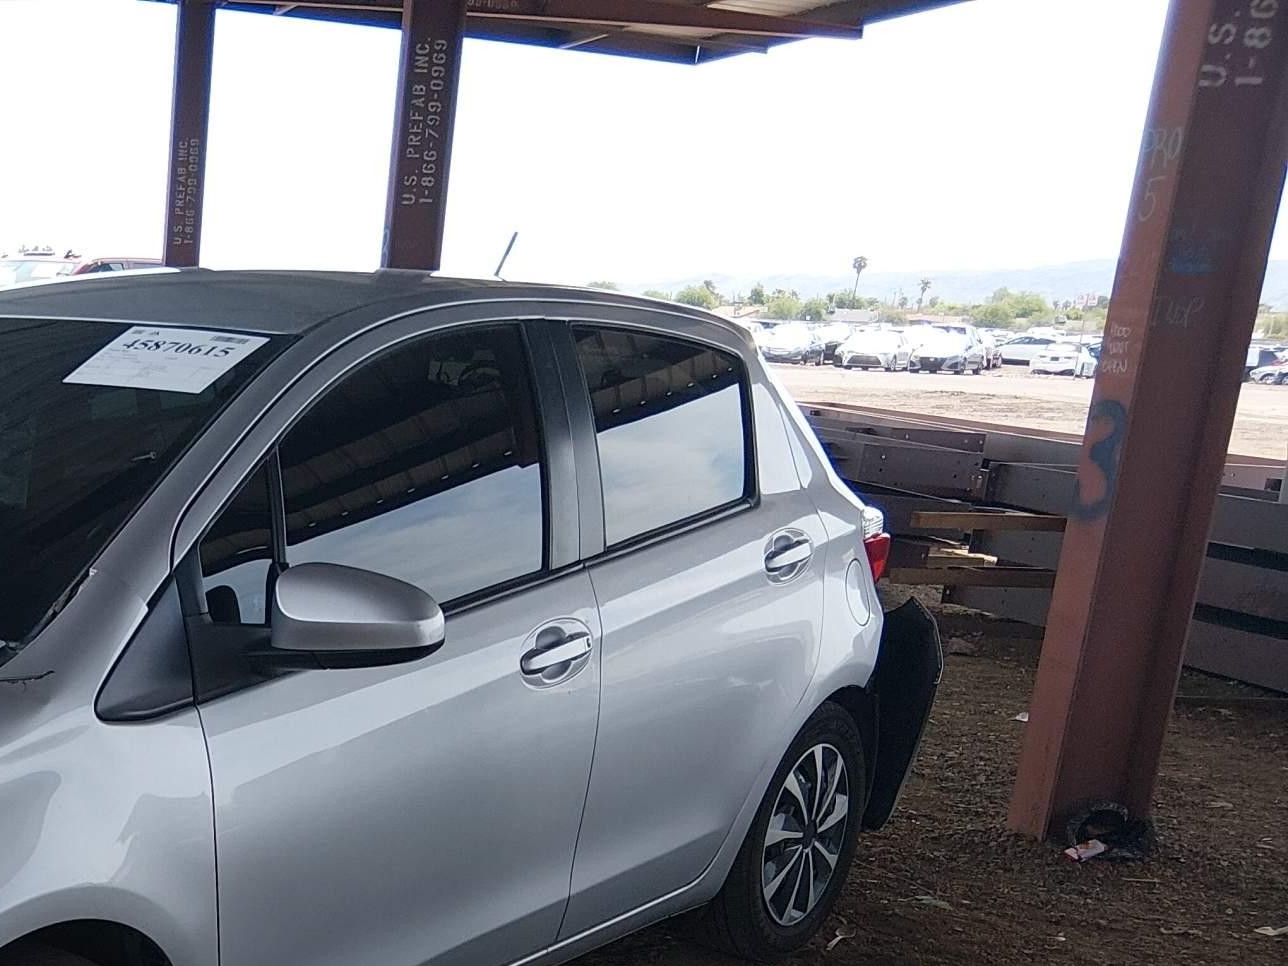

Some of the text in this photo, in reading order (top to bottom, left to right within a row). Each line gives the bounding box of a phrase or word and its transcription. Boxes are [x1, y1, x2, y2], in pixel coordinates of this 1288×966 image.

[1198, 10, 1241, 87] U.S.
[400, 37, 432, 206] U.S. PREFAB INC.
[419, 38, 448, 204] 1-866-799-0969
[172, 136, 189, 246] U.S. PREFAB INC.
[184, 138, 199, 245] 1-866-799-0969
[122, 338, 237, 358] 45870615
[1070, 400, 1128, 521] 3
